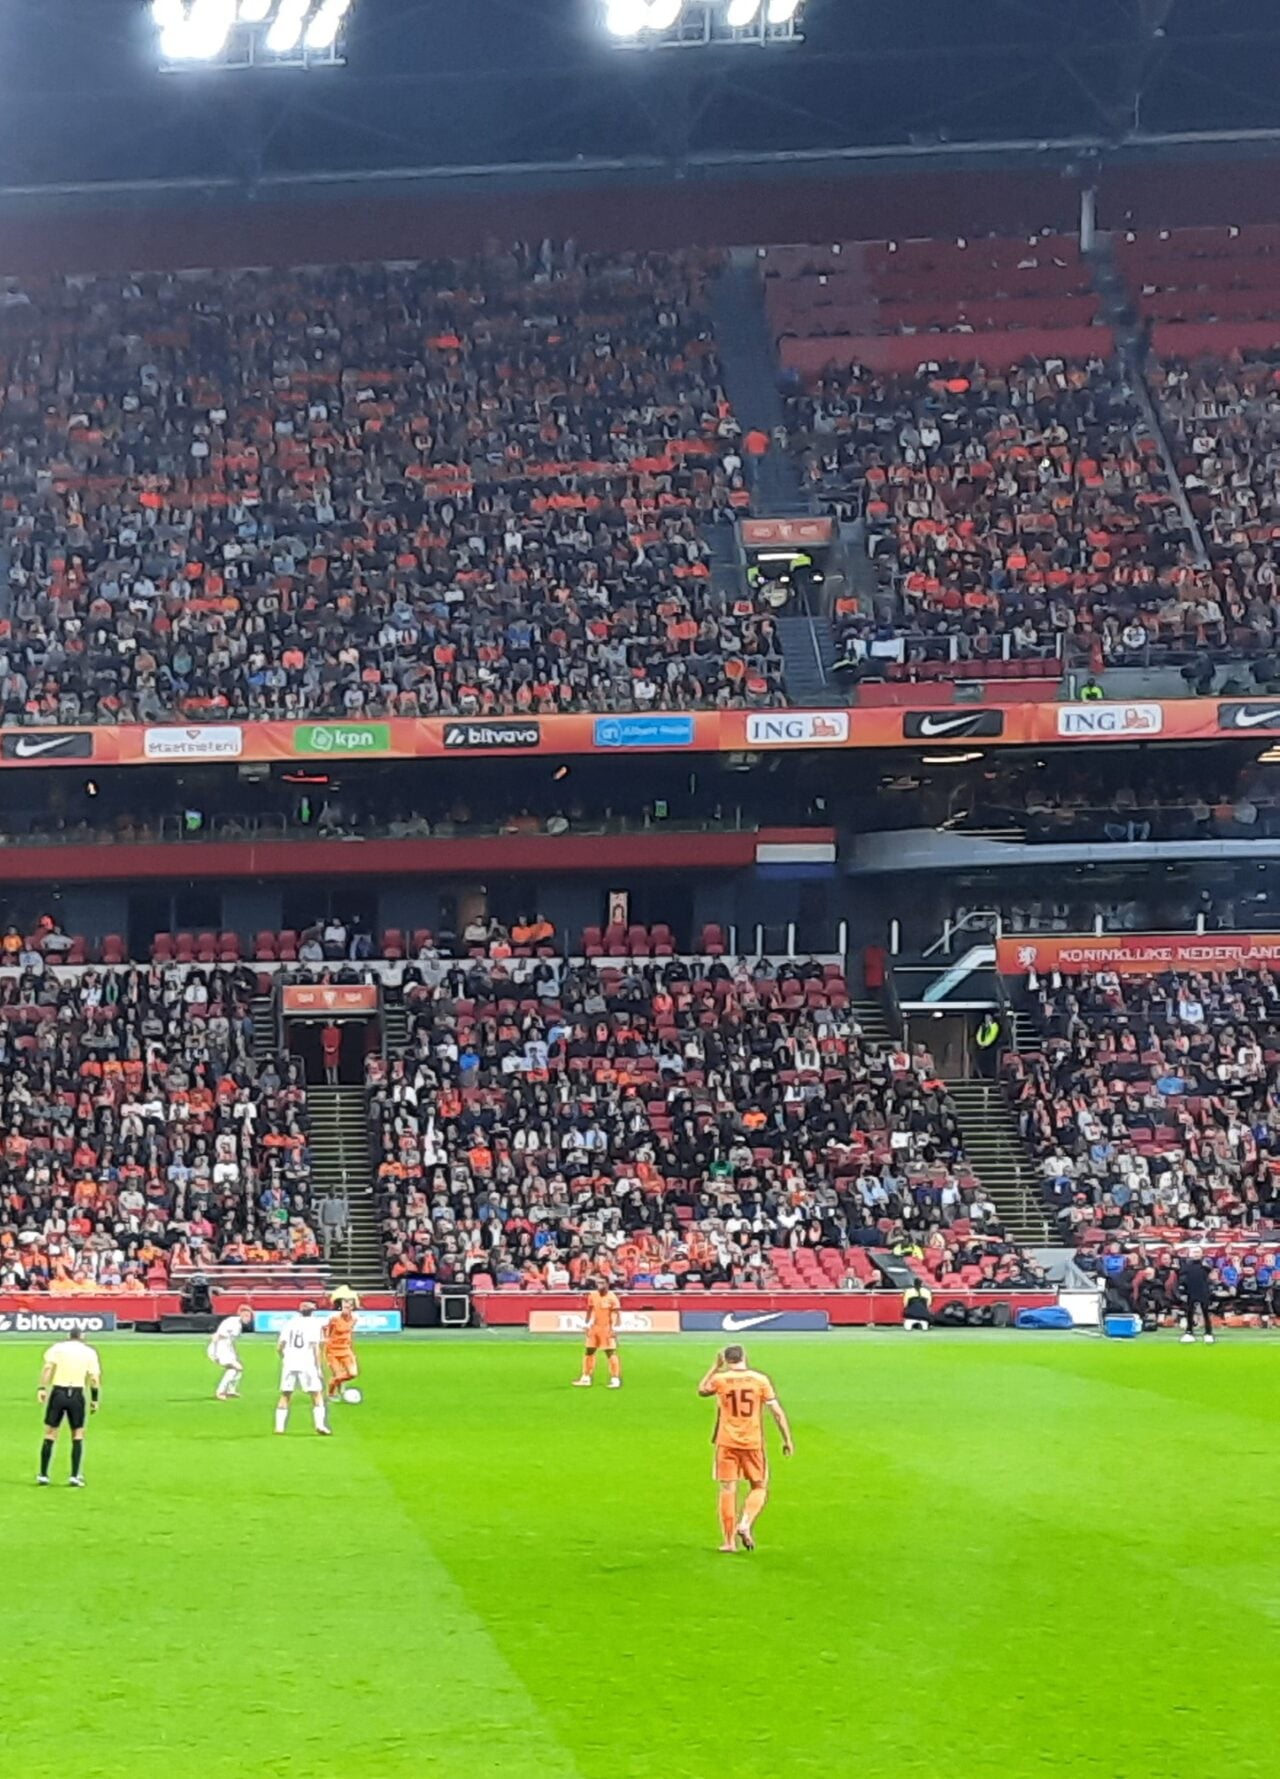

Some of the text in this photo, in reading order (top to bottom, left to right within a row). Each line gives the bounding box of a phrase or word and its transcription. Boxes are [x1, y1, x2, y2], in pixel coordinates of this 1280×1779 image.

[752, 721, 803, 739] ING
[1064, 713, 1116, 731] ING
[335, 731, 373, 747] kpn
[468, 728, 538, 743] bitvavo
[1058, 948, 1173, 962] KONINKLIJKE
[16, 1314, 103, 1331] bitvavo
[726, 1389, 754, 1417] 15
